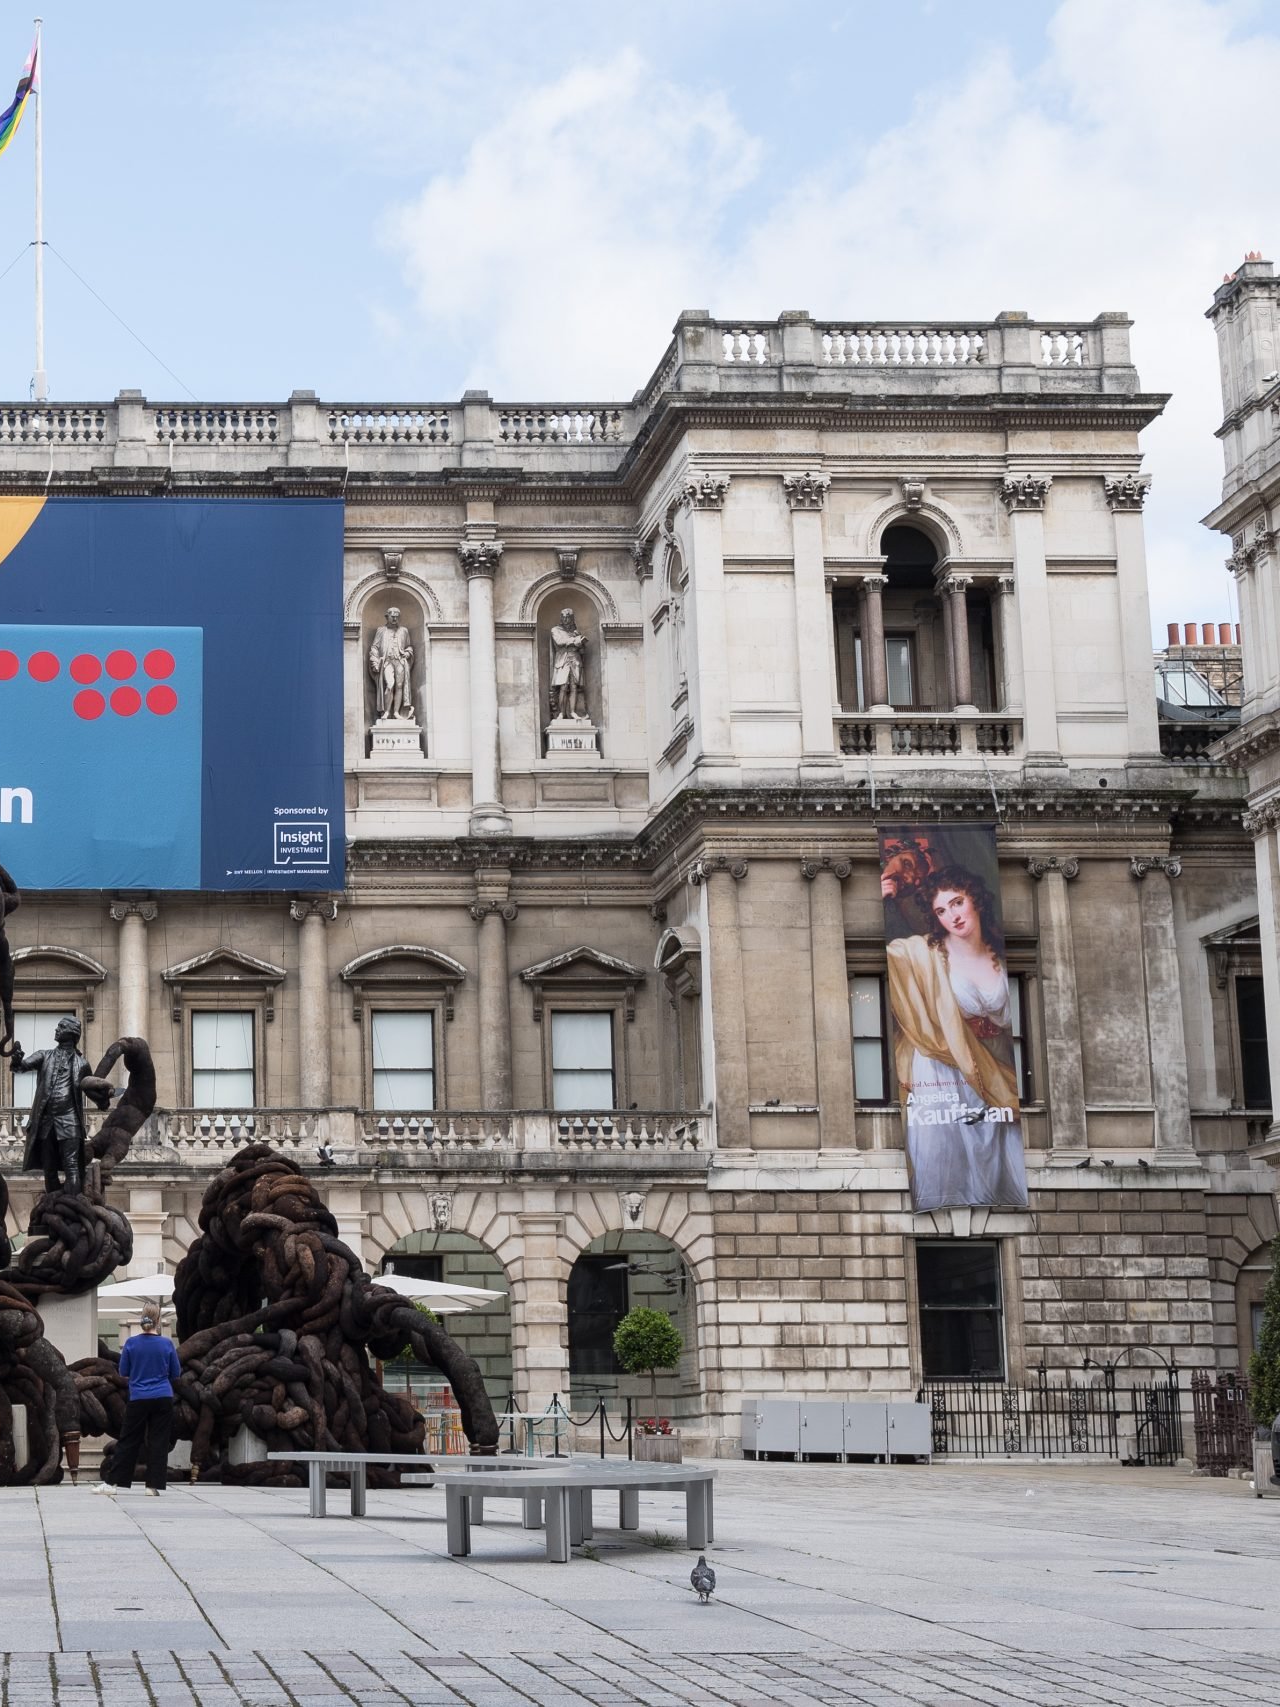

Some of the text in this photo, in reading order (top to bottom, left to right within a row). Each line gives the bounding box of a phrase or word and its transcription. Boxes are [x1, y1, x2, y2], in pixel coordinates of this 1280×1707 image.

[274, 807, 328, 816] Sponsored by
[280, 831, 323, 845] Insight
[907, 1091, 960, 1105] Angelica
